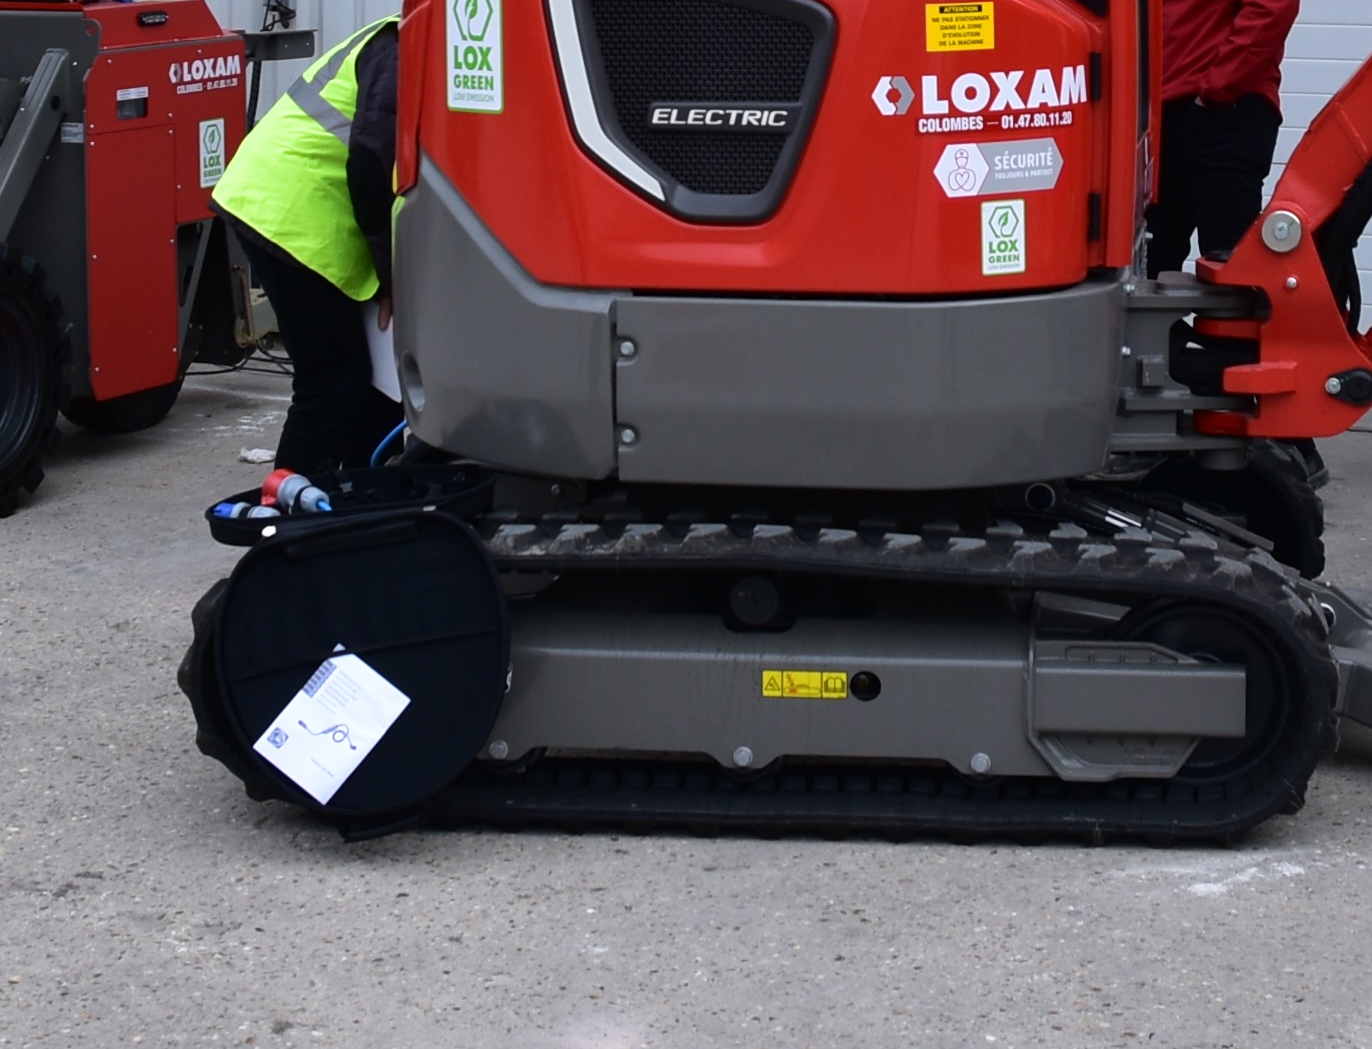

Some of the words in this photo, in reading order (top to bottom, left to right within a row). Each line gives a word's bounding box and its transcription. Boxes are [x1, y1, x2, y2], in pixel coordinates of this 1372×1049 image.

[182, 54, 241, 82] LOXAM
[453, 45, 494, 72] LOX
[453, 74, 494, 91] GREEN
[921, 64, 1088, 115] LOXAM
[651, 108, 788, 127] ELECTRIC
[918, 115, 984, 133] COLOMBES
[1001, 110, 1073, 130] 01.47.80.11.20
[203, 153, 221, 169] LOX
[994, 146, 1053, 170] SÉCURITÉ
[988, 238, 1019, 254] LOX
[988, 253, 1020, 264] GREEN
